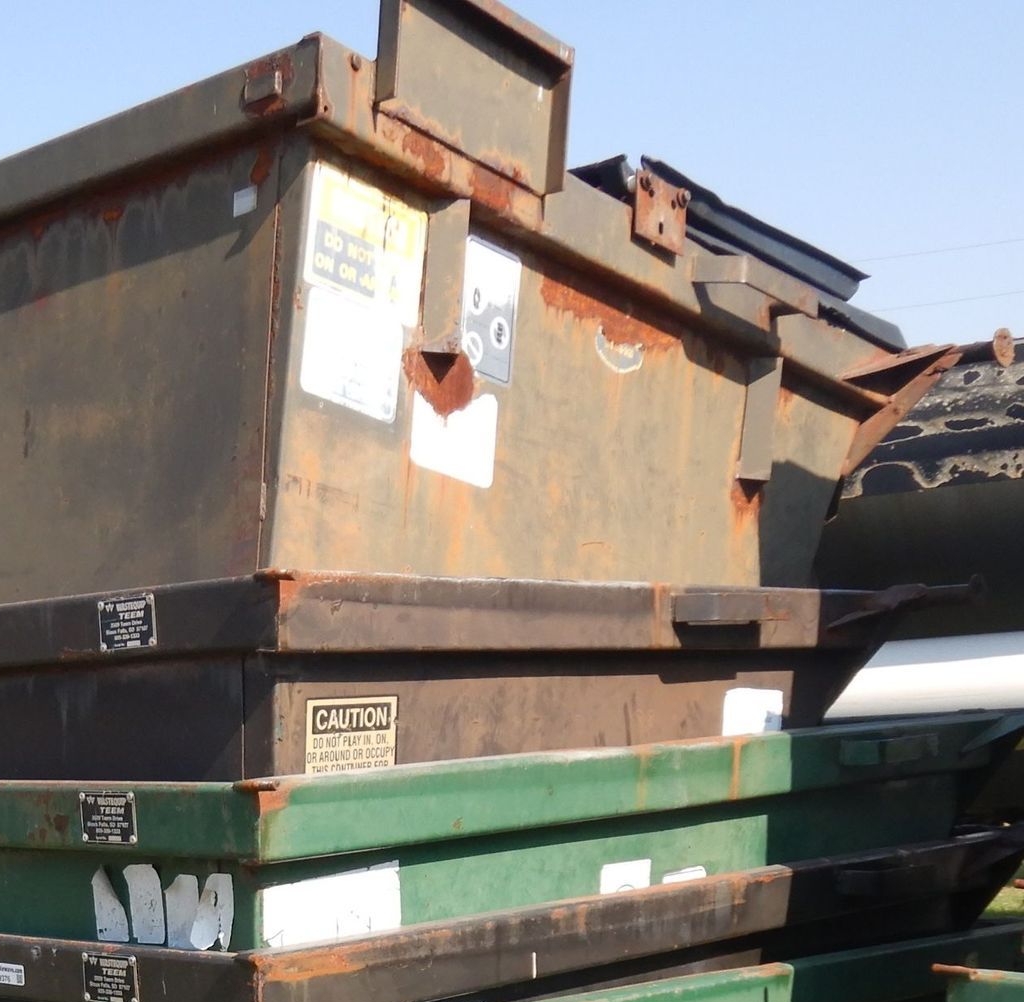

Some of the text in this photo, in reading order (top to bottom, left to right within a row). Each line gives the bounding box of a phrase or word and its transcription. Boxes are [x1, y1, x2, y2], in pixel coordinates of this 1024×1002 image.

[119, 610, 144, 620] TEEM
[317, 707, 388, 730] CAUTION
[313, 738, 323, 749] DO
[326, 736, 340, 748] NOT
[343, 736, 362, 746] PLAY
[307, 746, 394, 764] OR AROUND OR OCCUPY
[102, 968, 126, 976] TEEM
